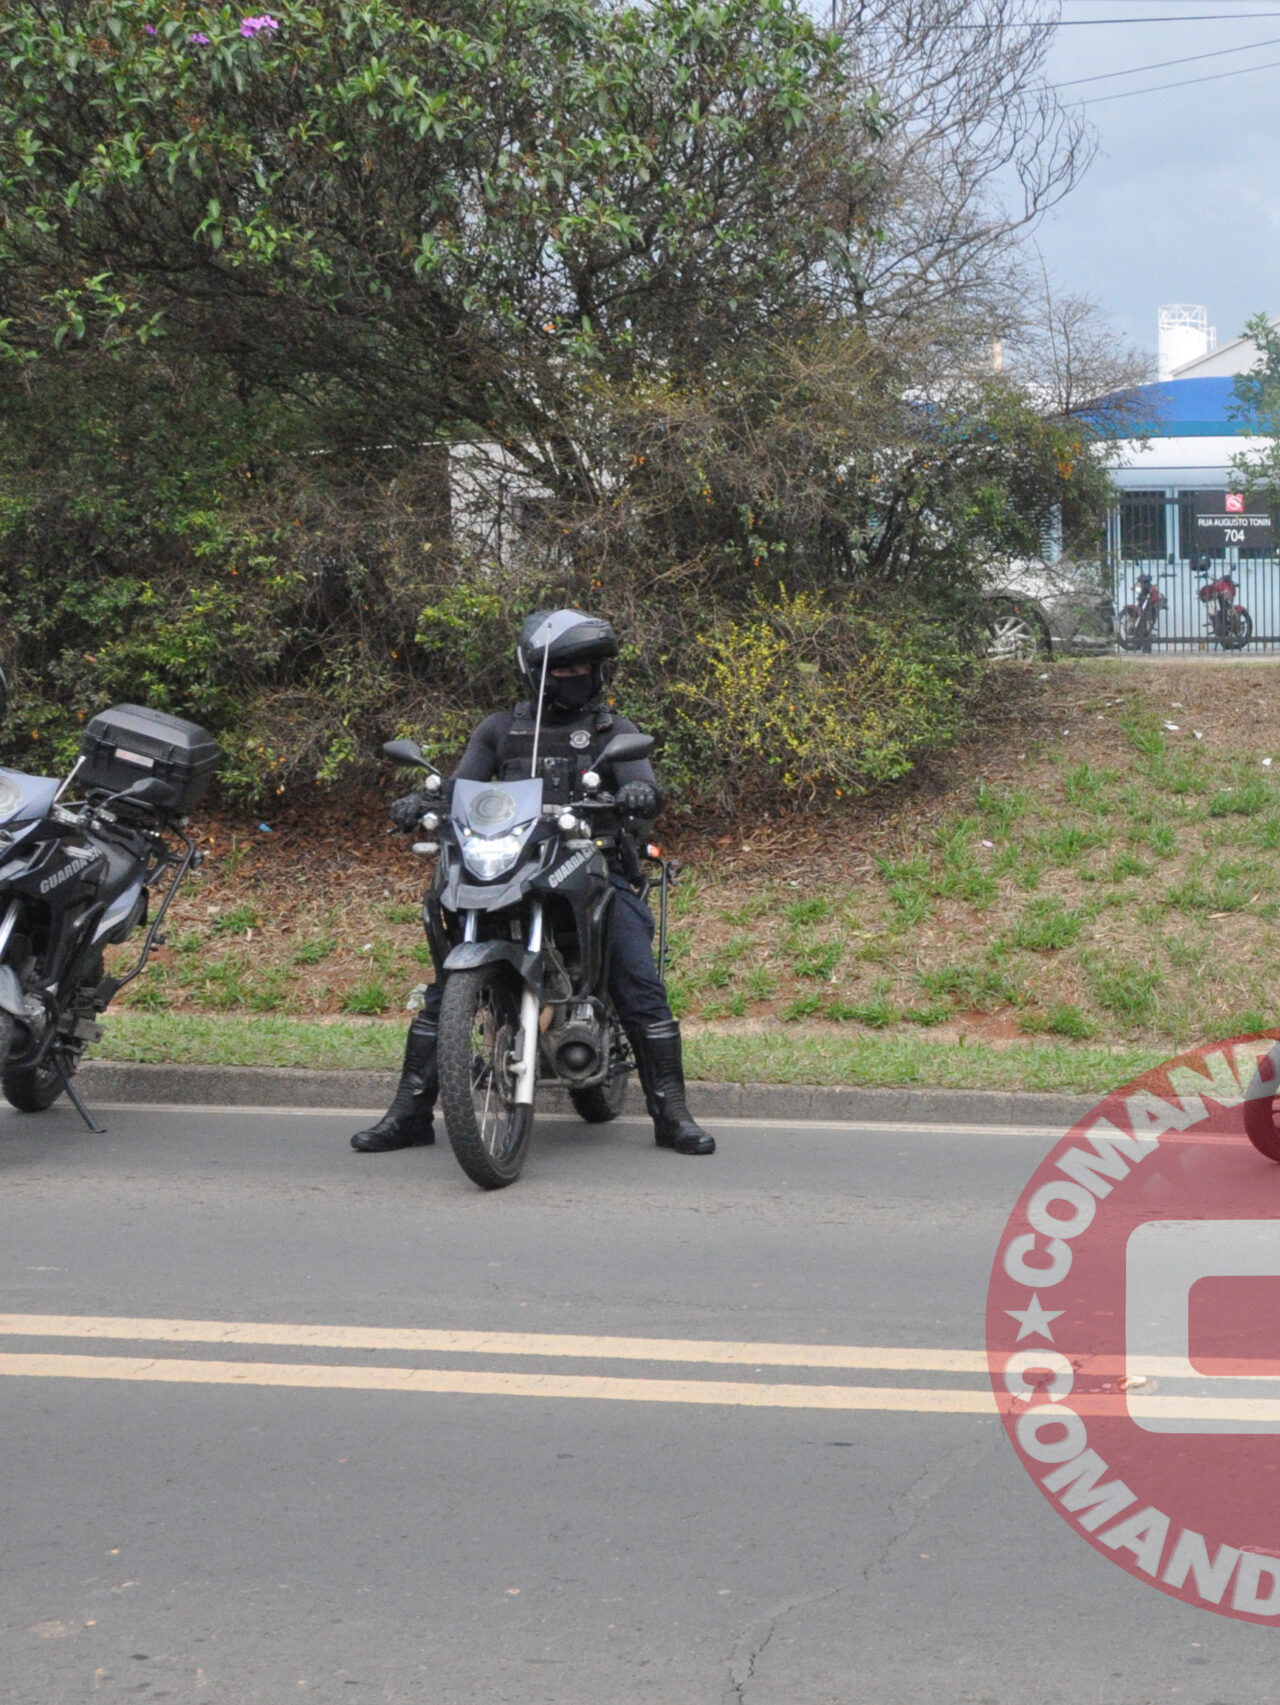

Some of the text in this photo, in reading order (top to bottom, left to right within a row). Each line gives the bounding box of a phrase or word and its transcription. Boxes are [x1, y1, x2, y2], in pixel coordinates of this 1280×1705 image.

[1197, 518, 1271, 527] RUA AUGUSTO TONIN
[1224, 529, 1245, 542] 704
[40, 859, 88, 894] GUARDA
[548, 851, 586, 888] GUARDA
